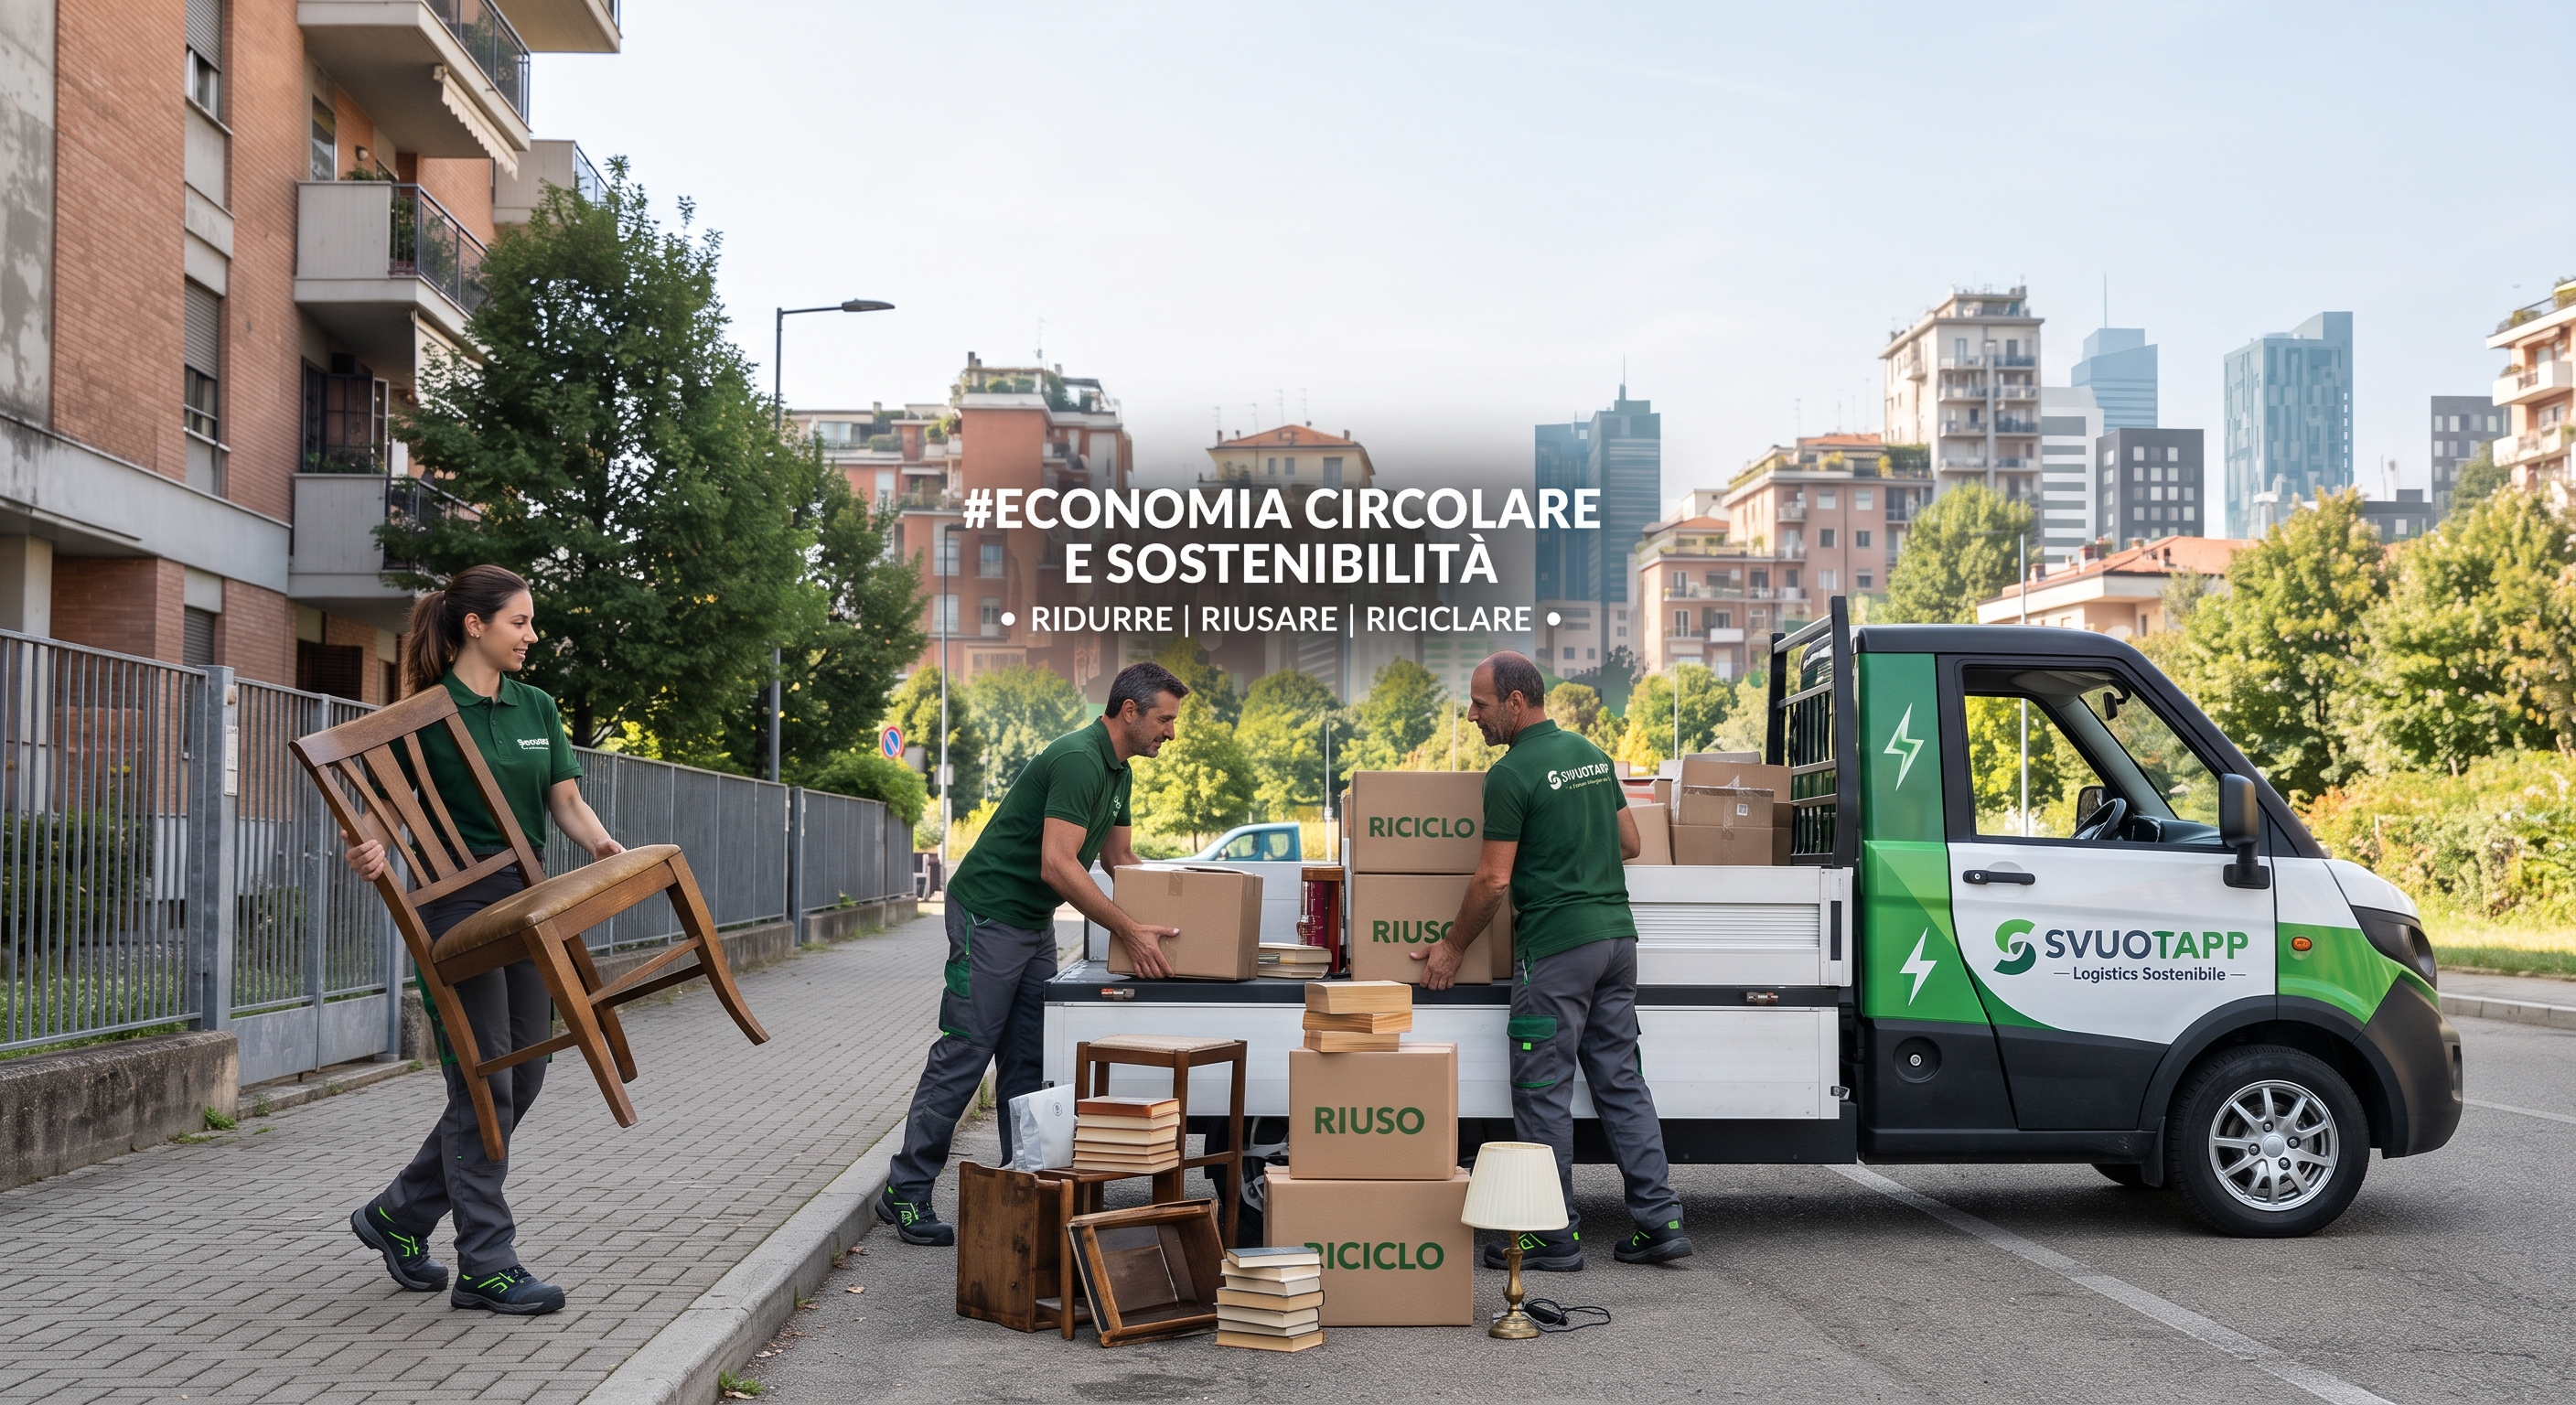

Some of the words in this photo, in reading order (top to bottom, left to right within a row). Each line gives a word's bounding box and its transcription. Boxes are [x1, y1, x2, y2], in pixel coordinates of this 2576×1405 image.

[1369, 816, 1476, 839] RICICLO
[2045, 929, 2249, 960] SVUOTAPP
[2073, 966, 2138, 983] Logistics
[2142, 966, 2226, 981] Sostenibile
[1315, 1106, 1425, 1135] RIUSO
